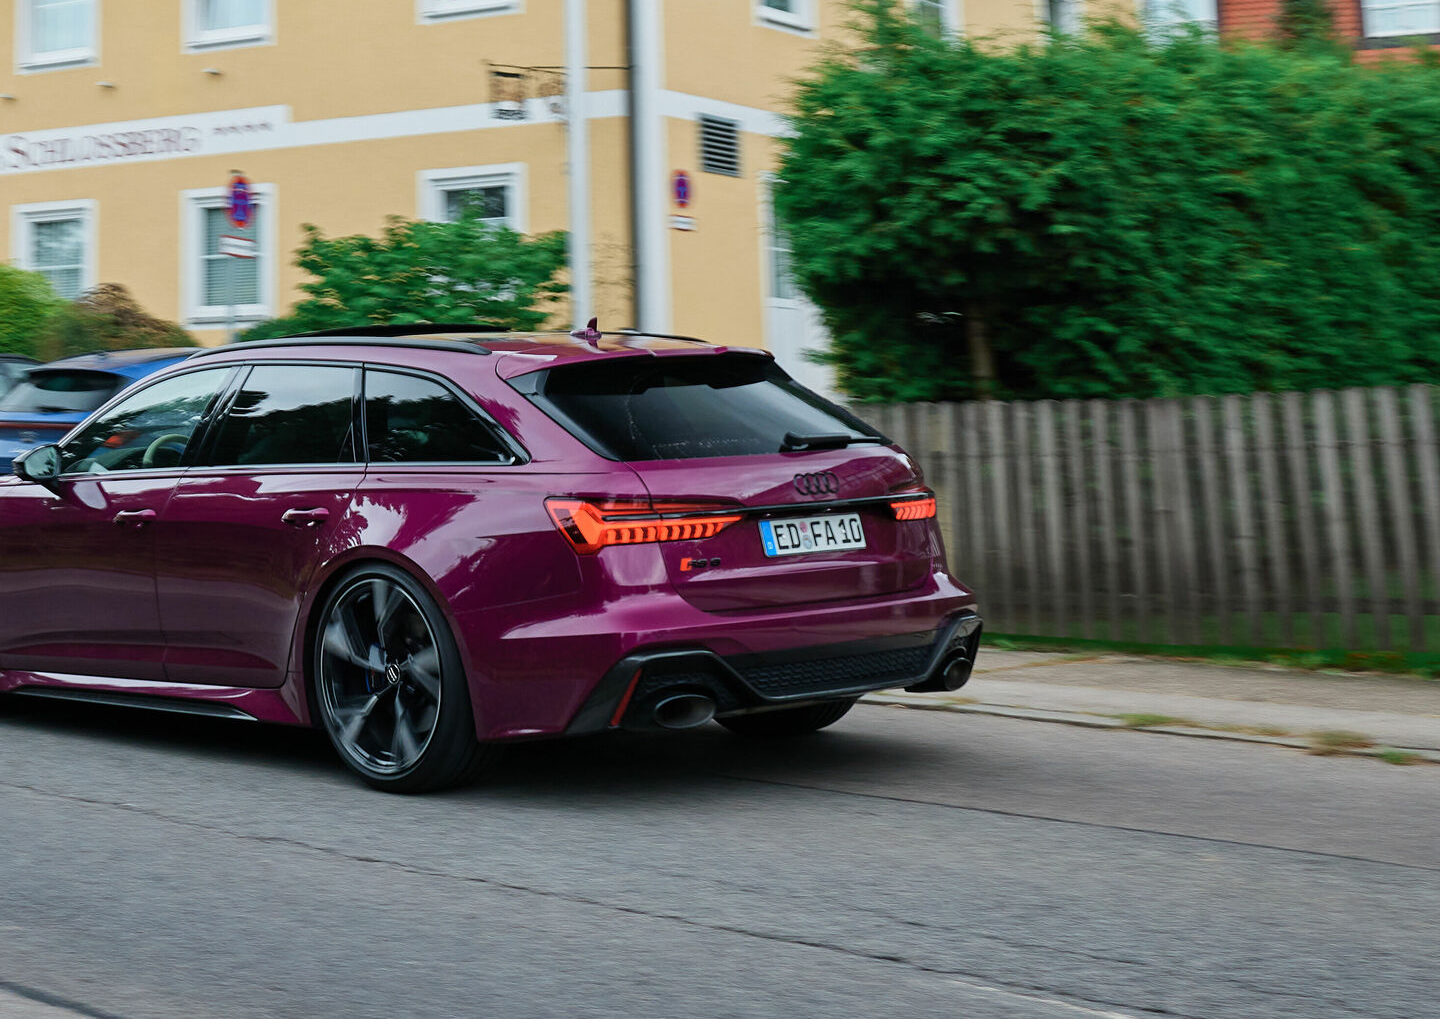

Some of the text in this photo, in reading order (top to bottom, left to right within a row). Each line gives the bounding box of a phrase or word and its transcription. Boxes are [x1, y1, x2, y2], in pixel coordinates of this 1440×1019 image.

[773, 517, 862, 550] ED FA 10
